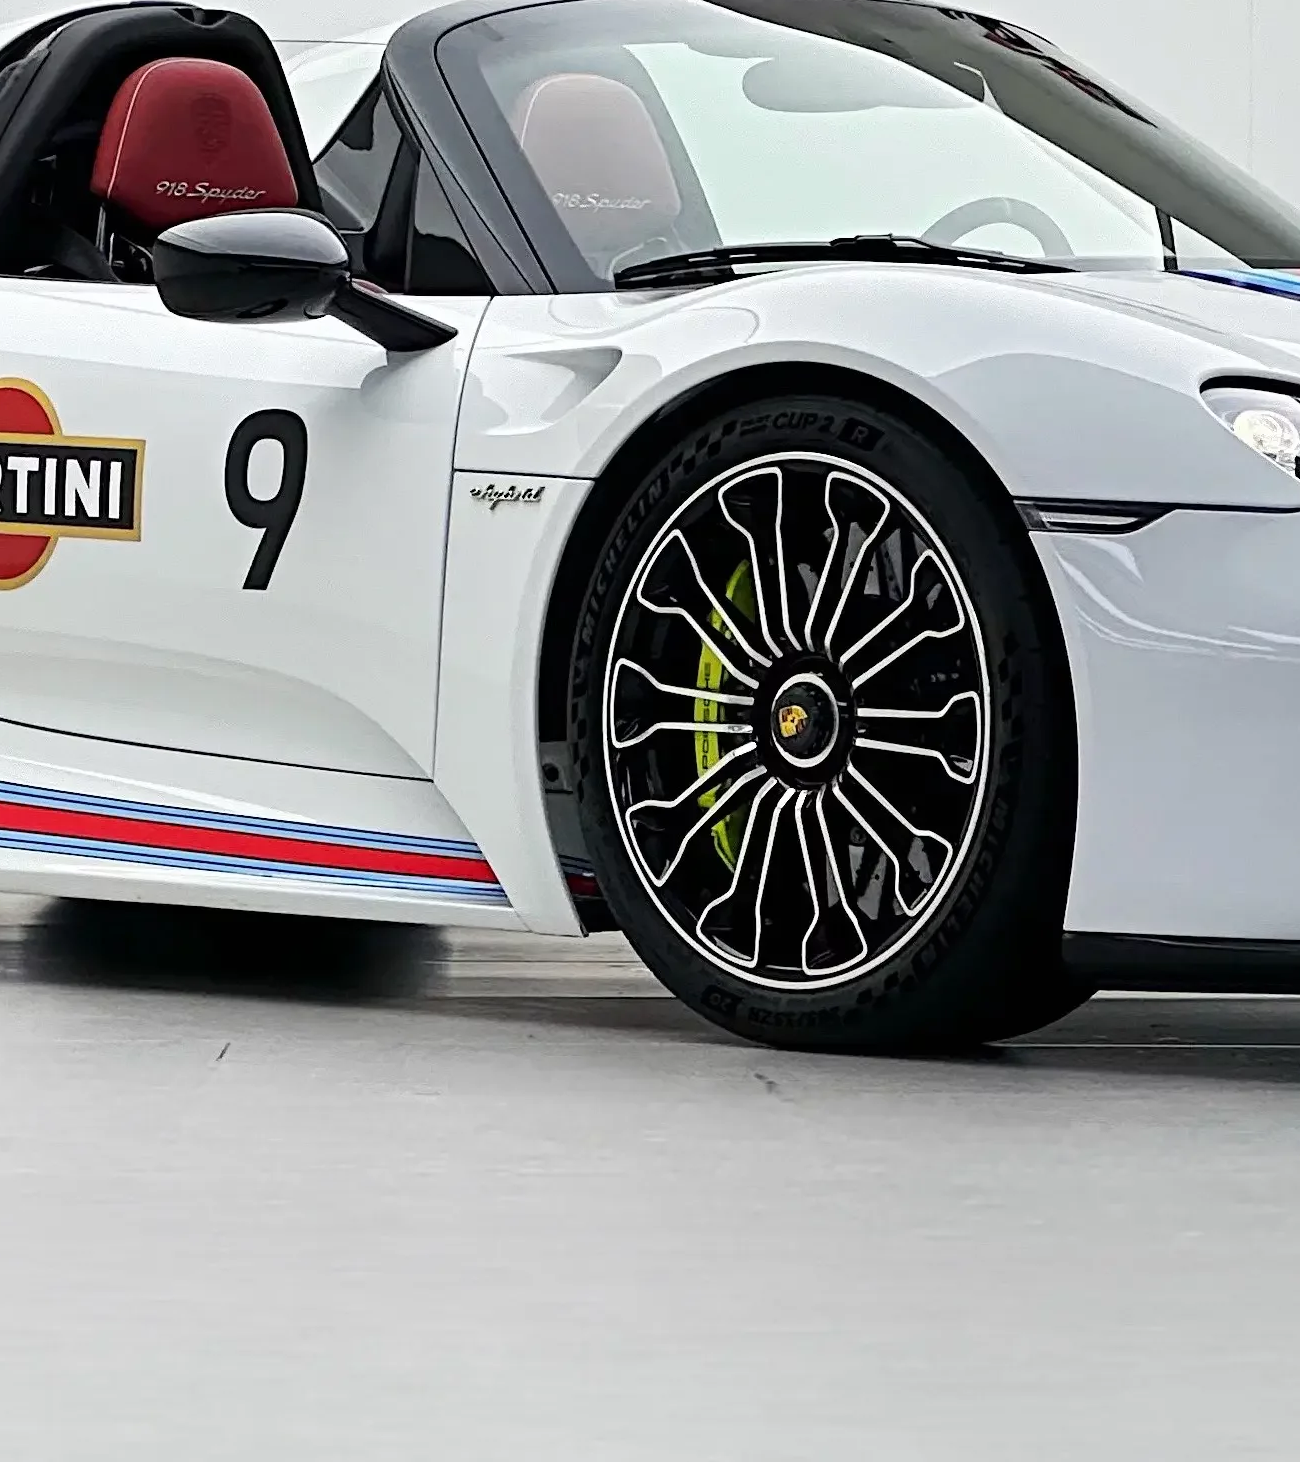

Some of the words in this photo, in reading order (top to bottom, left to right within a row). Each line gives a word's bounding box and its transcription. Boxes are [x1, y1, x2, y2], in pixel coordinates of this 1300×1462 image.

[156, 181, 188, 196] 918
[186, 182, 266, 204] Spyder
[772, 413, 819, 430] CUP
[818, 415, 835, 433] 2
[850, 424, 871, 445] R
[224, 408, 309, 590] 9
[581, 477, 663, 646] MICHELIN
